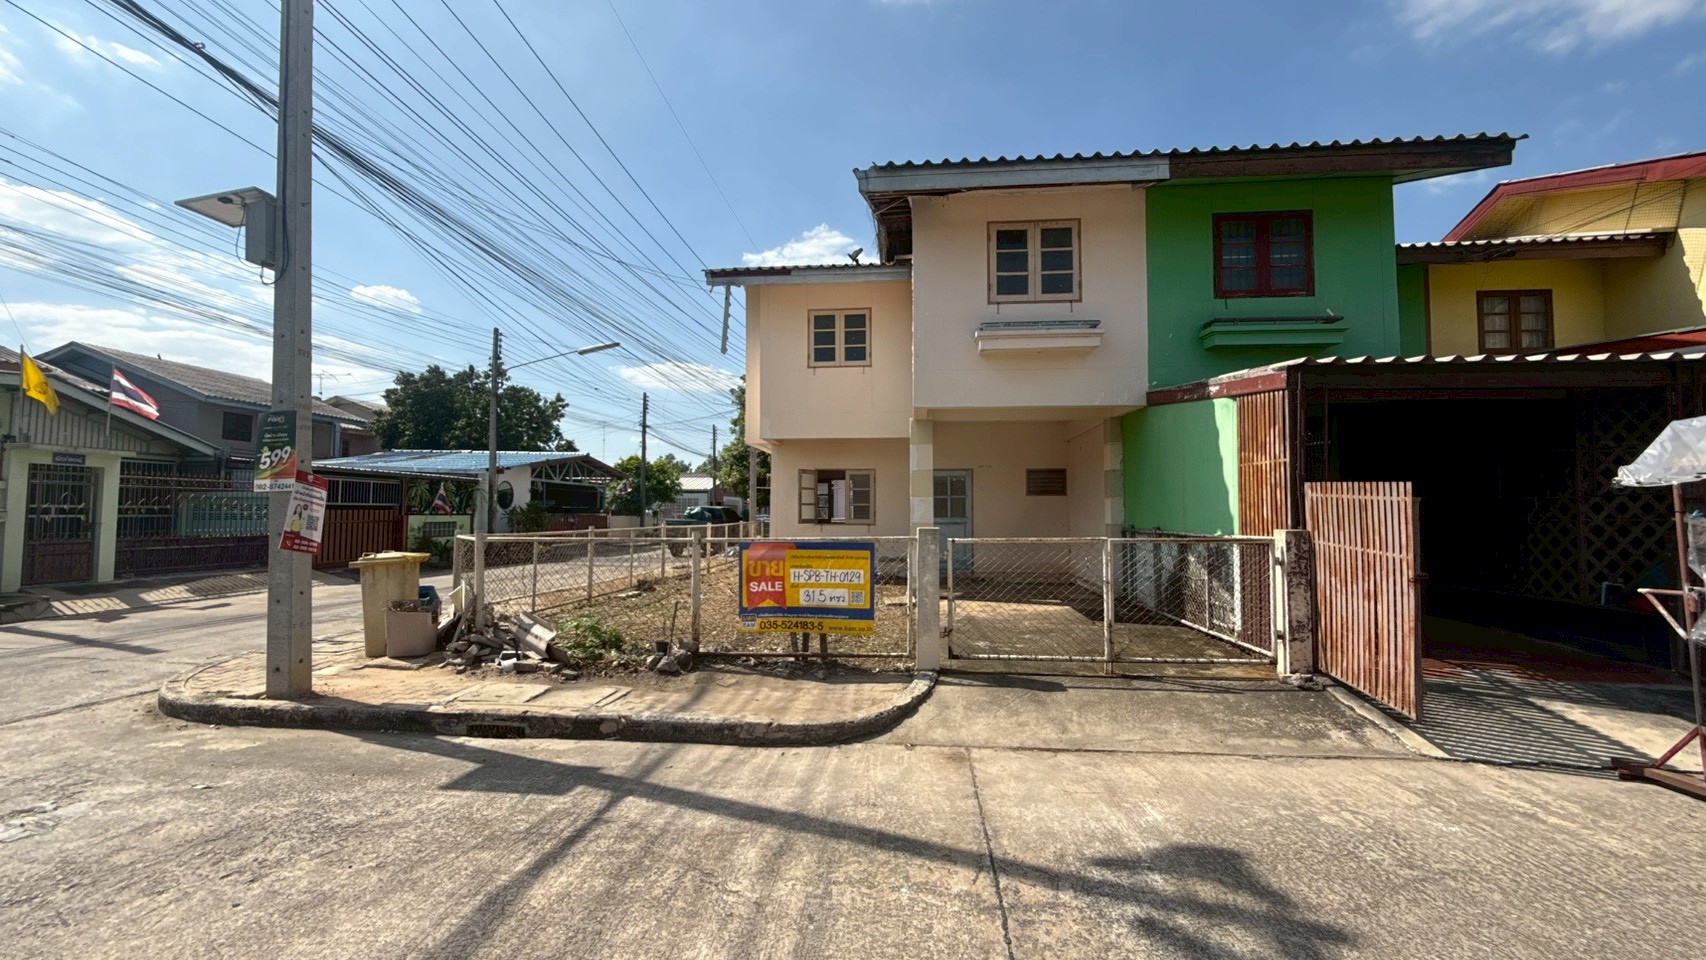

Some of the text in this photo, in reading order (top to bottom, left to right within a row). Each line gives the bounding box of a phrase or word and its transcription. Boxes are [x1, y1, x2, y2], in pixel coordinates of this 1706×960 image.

[259, 446, 291, 470] 599
[749, 560, 784, 577] ขาย
[749, 581, 783, 592] SALE
[759, 620, 824, 631] 035-524183-5
